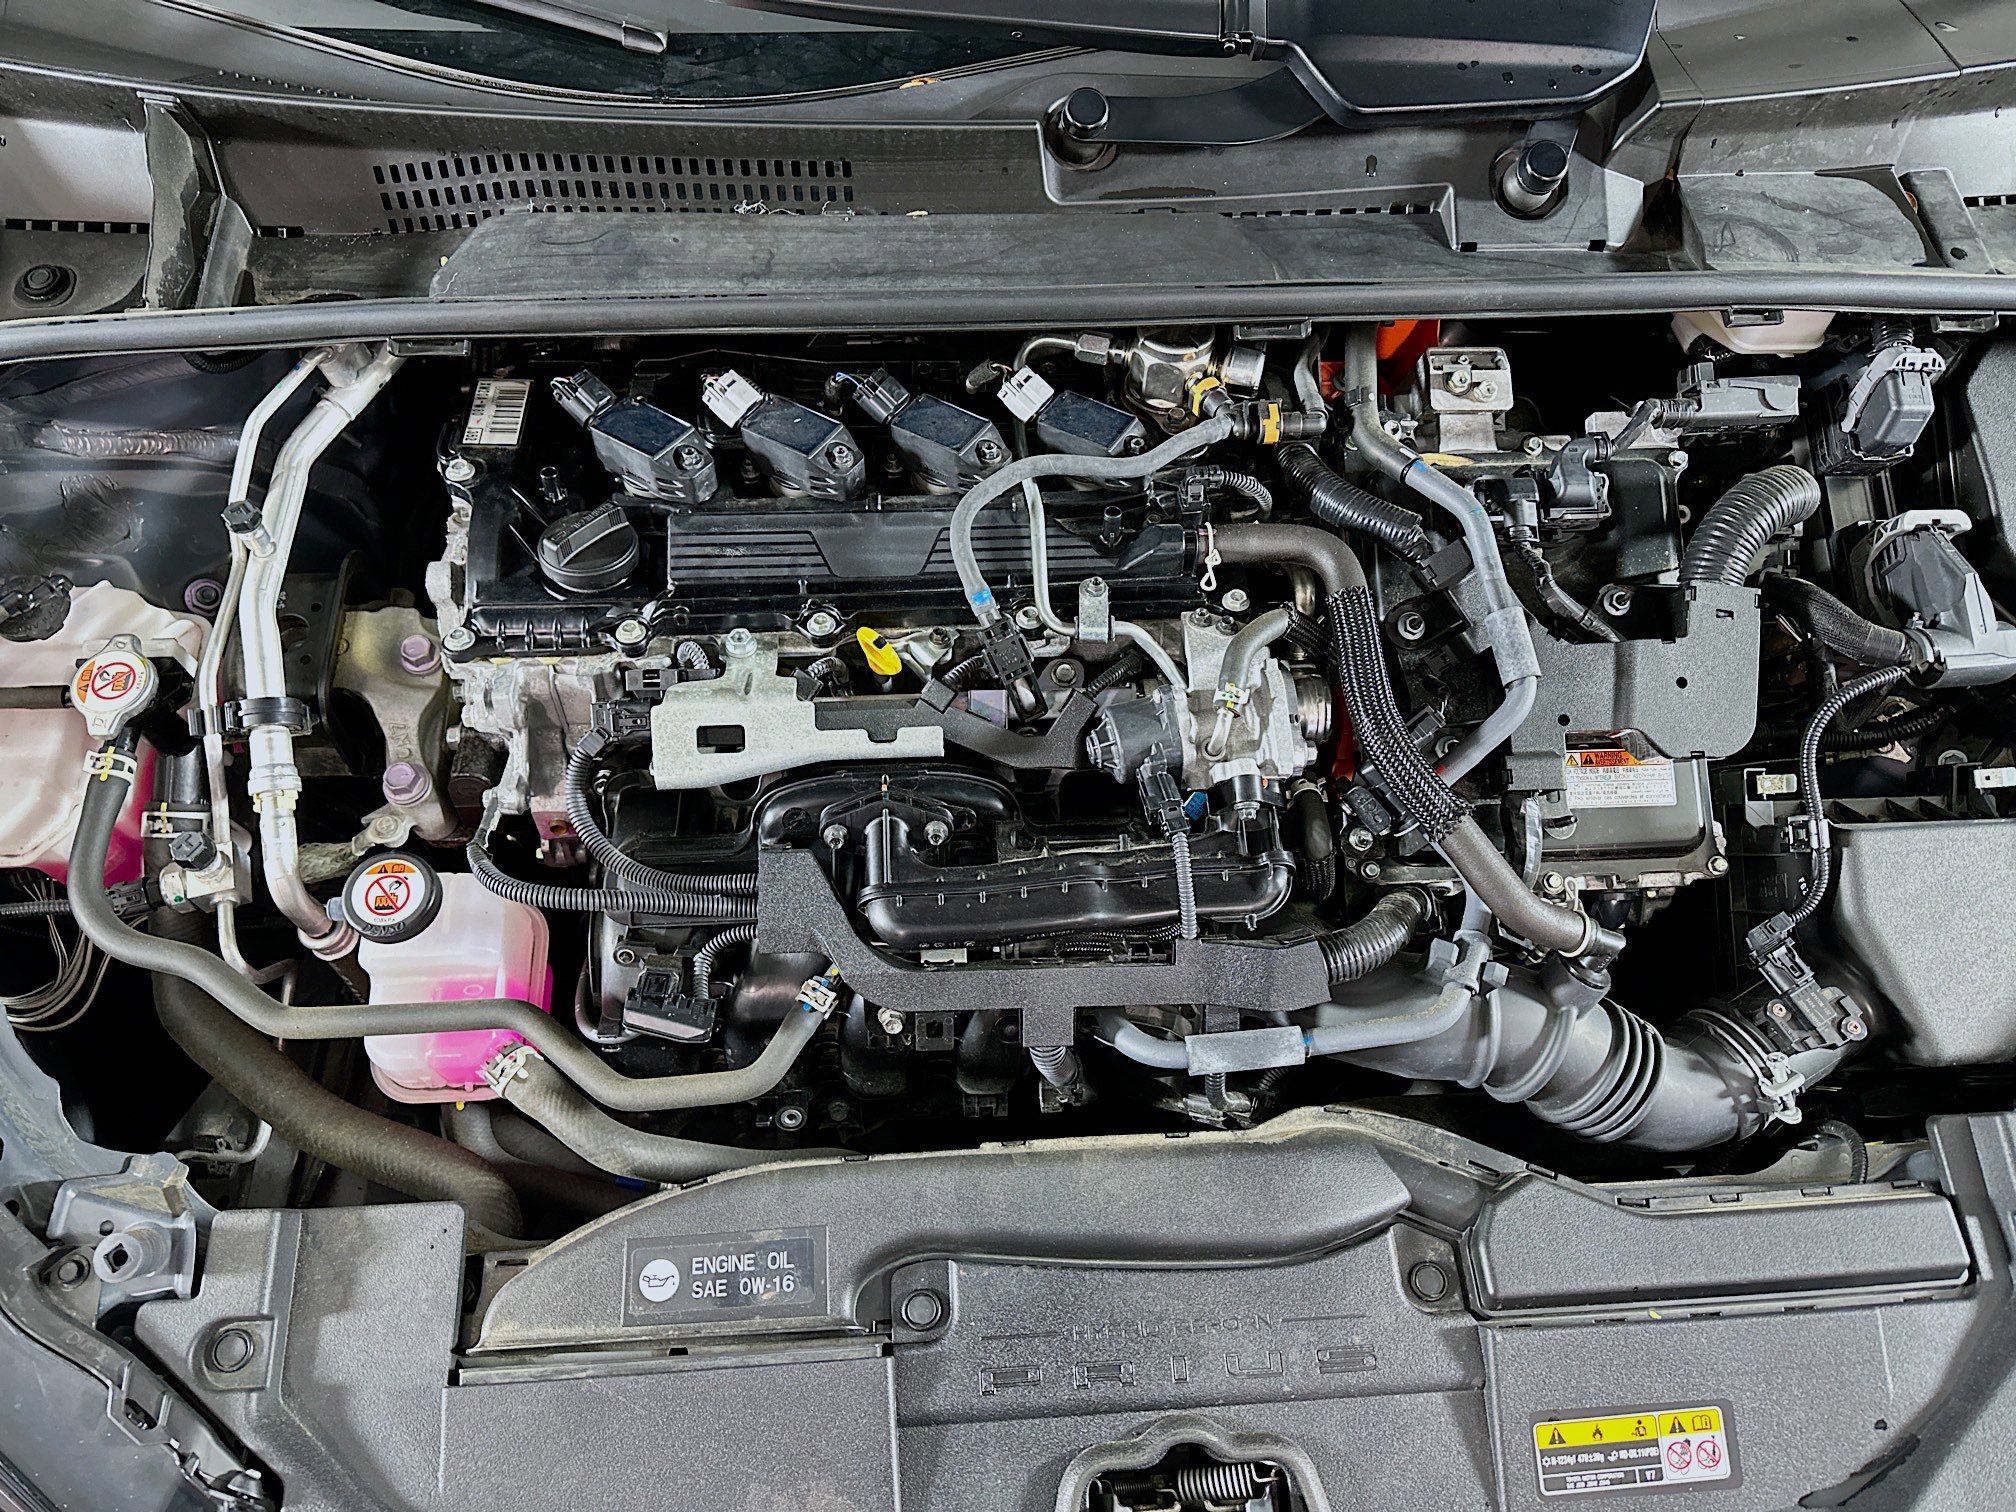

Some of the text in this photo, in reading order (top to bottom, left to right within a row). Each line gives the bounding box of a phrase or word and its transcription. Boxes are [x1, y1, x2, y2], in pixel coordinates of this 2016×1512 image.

[362, 921, 405, 936] DENSO
[692, 1251, 795, 1275] ENGINE OIL
[691, 1275, 795, 1299] SAE 0W-16
[980, 1345, 1377, 1395] PRIUS
